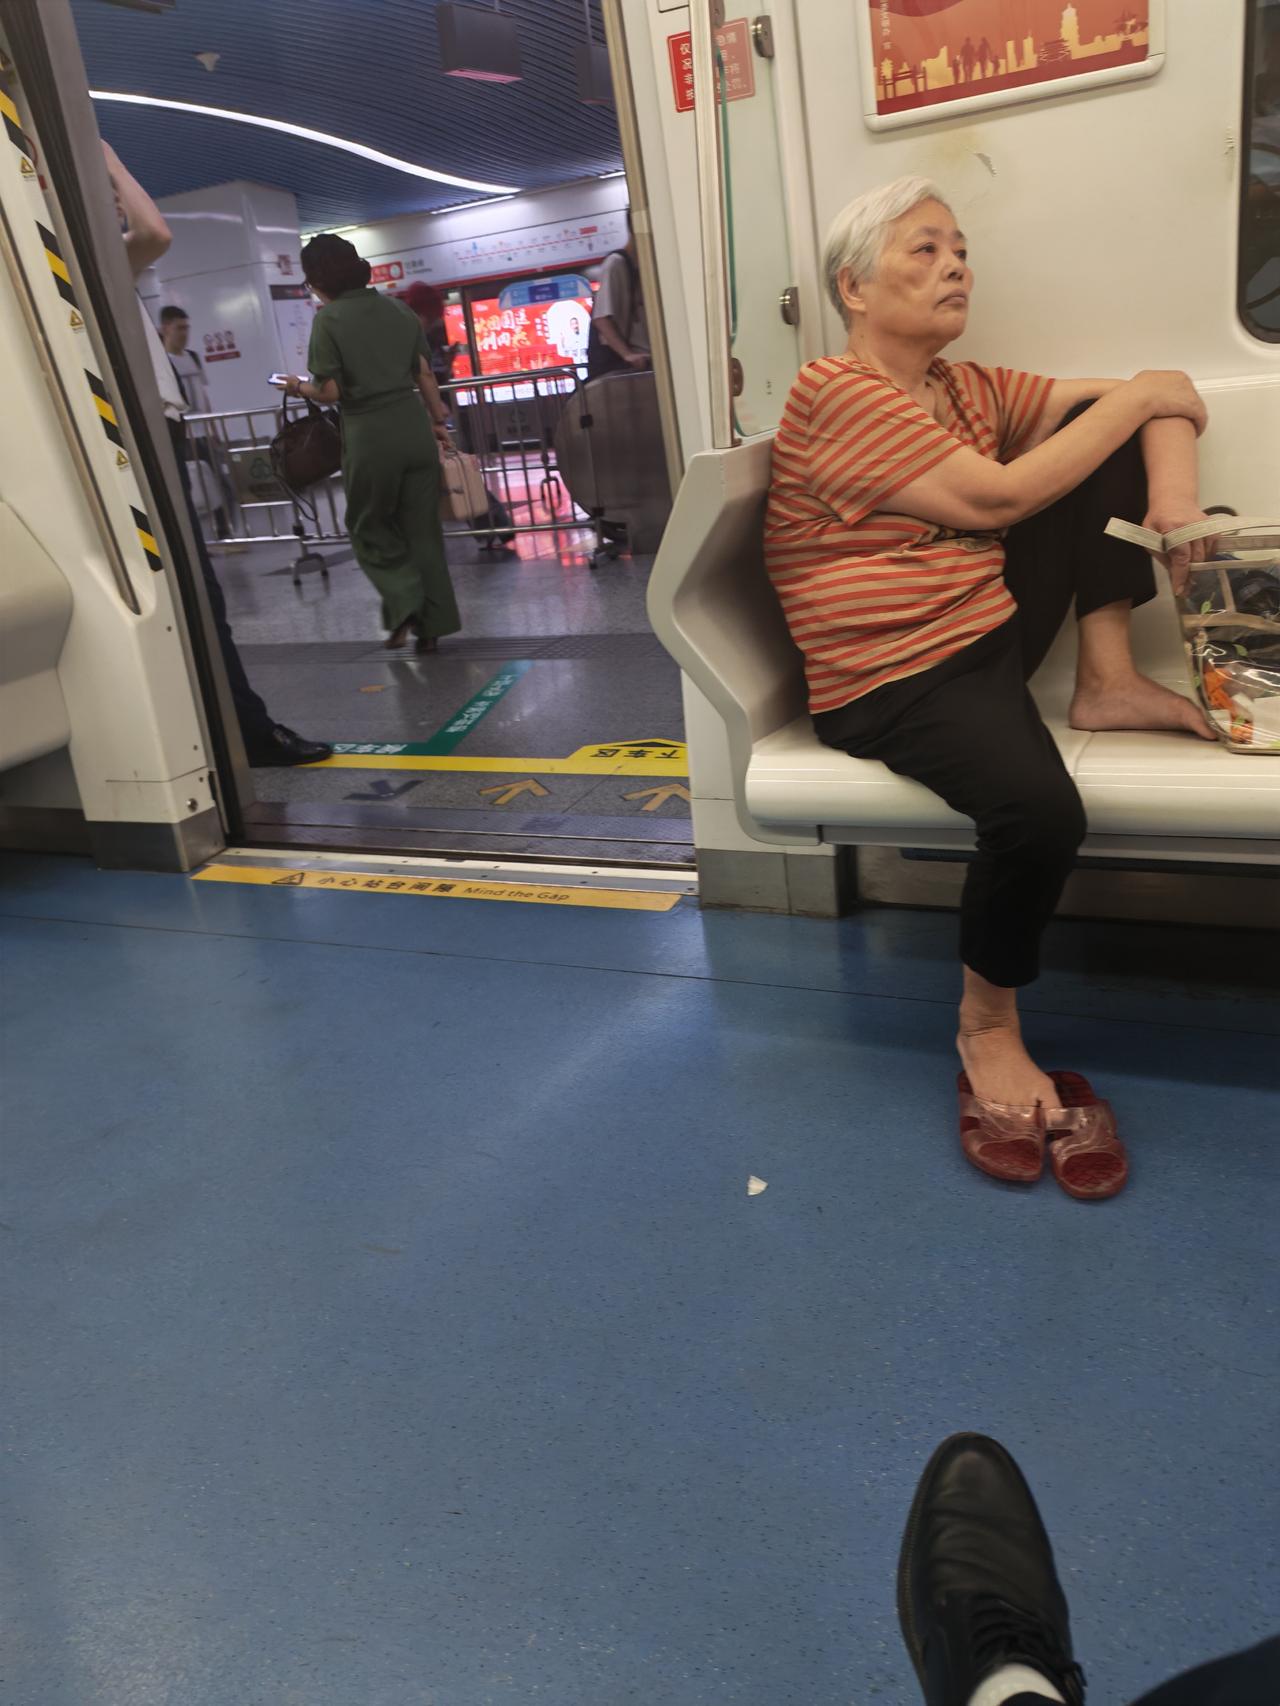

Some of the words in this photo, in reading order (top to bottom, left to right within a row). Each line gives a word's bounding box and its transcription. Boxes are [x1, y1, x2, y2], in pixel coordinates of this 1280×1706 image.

[589, 748, 681, 759] 下车区
[319, 876, 457, 893] 小心站台间隙
[463, 887, 506, 897] Mind
[507, 889, 534, 898] the
[537, 891, 570, 902] Gap
